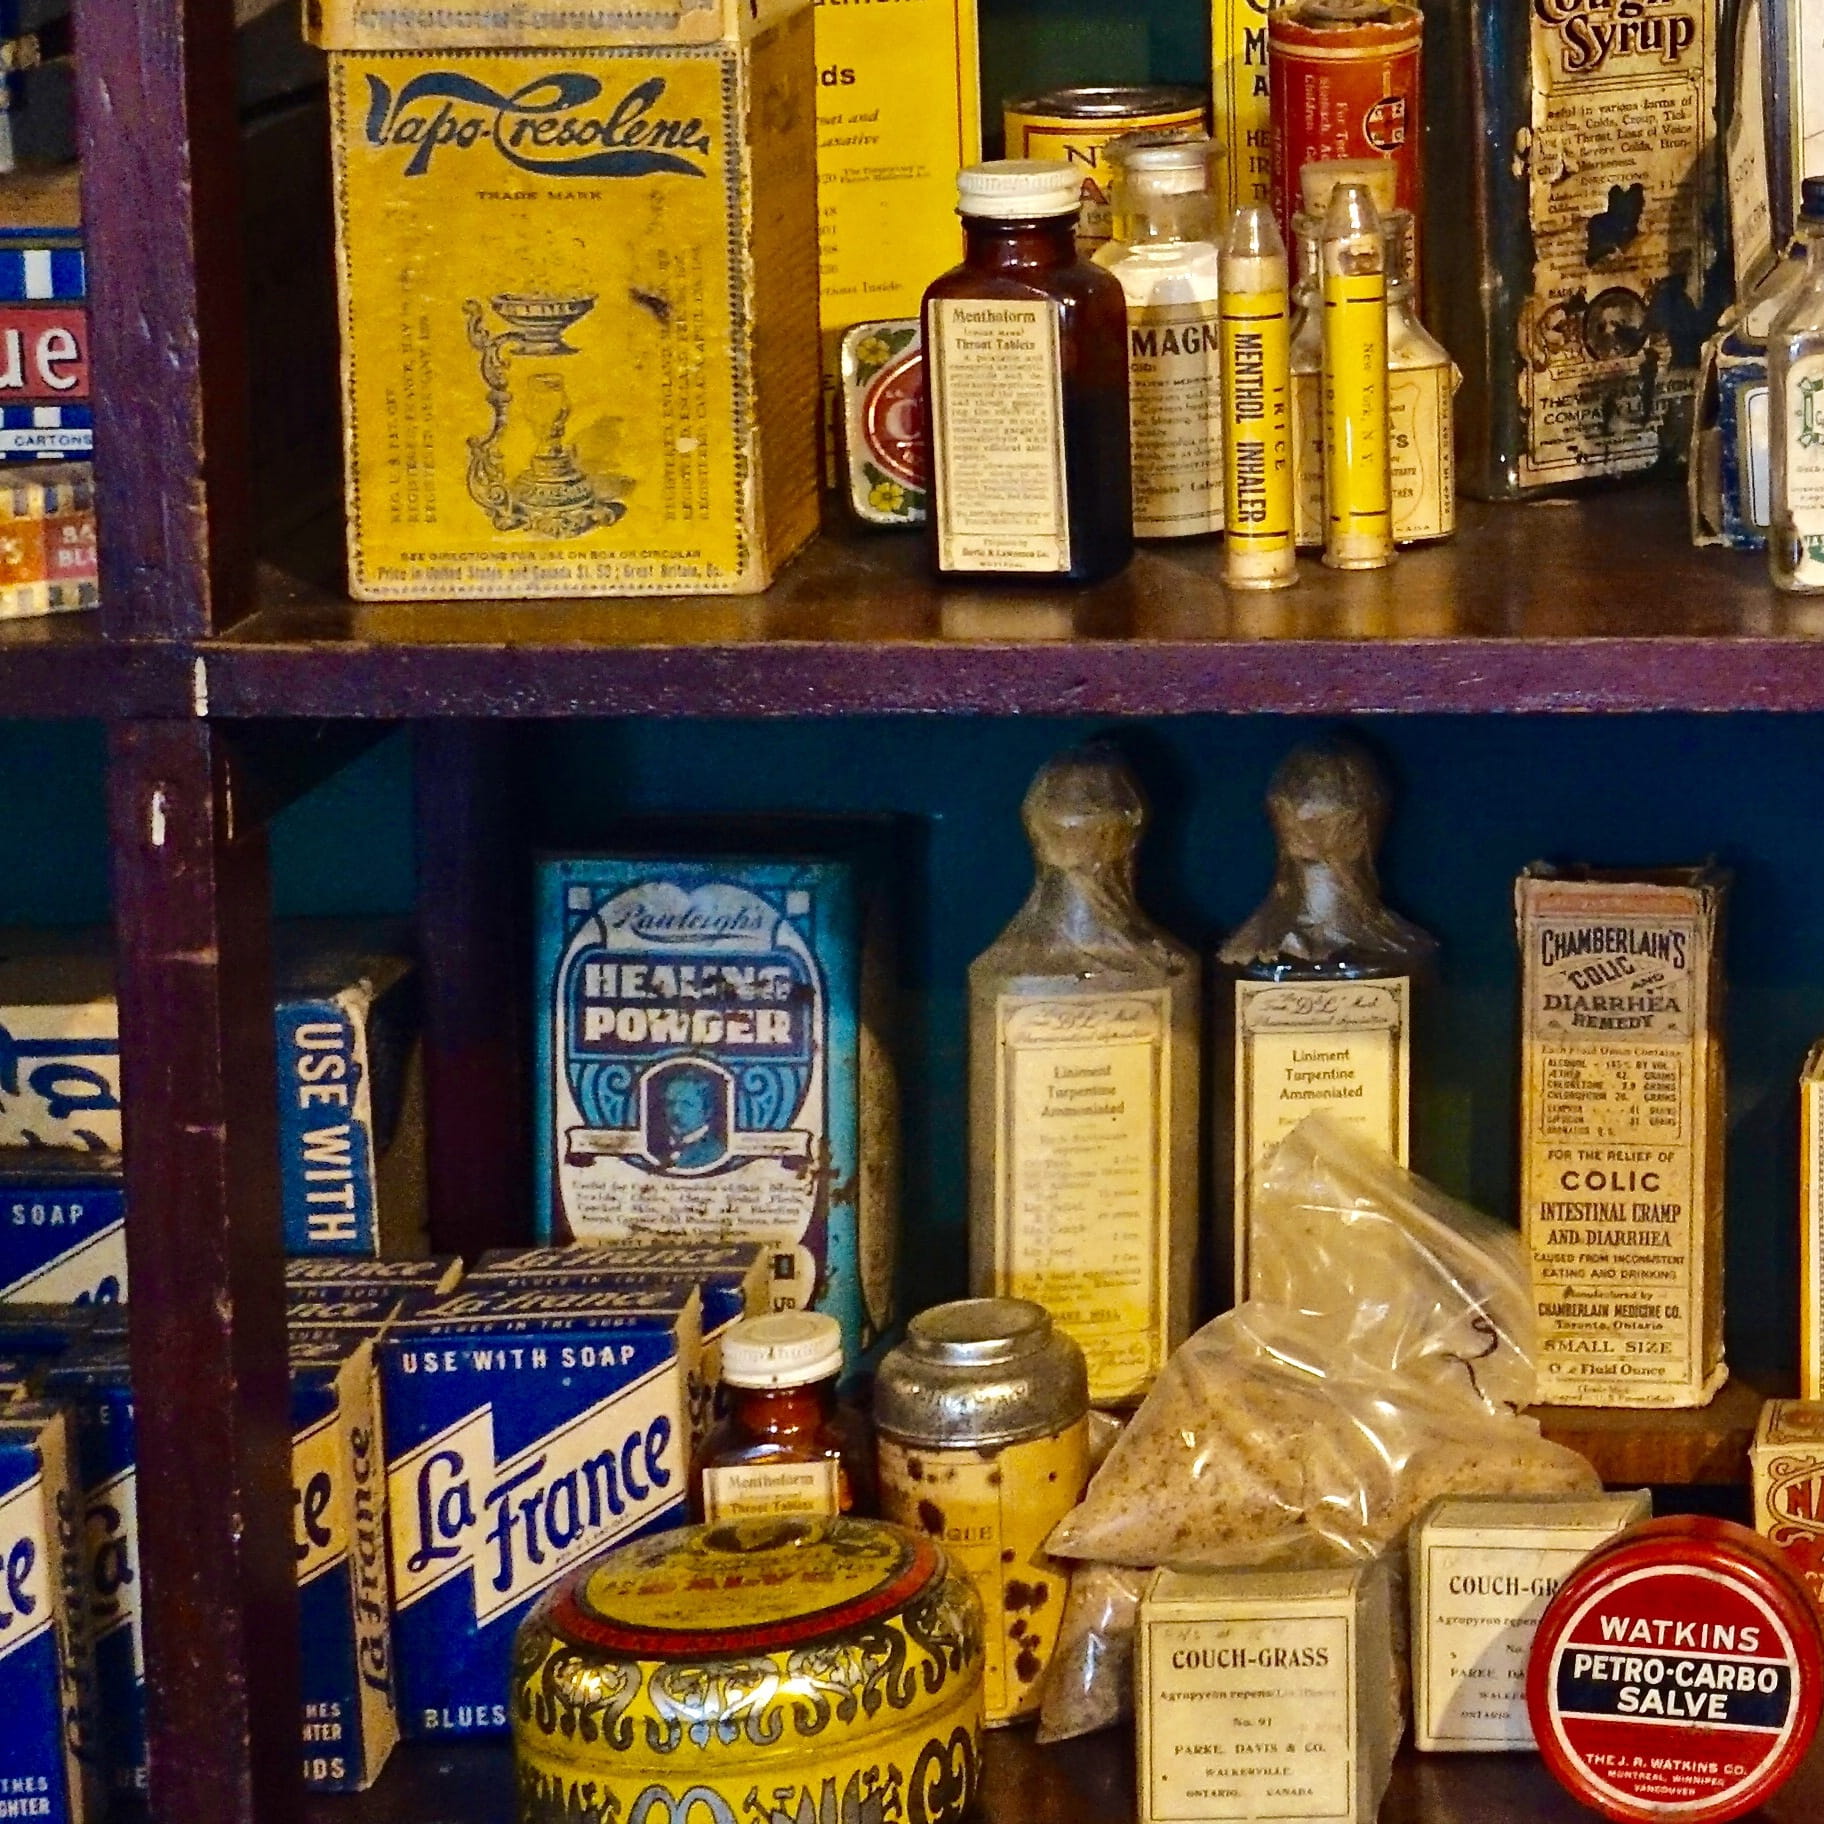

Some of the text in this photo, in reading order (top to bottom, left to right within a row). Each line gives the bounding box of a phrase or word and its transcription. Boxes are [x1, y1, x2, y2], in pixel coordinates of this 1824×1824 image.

[1561, 12, 1697, 73] Syrup
[1234, 330, 1268, 524] MENTHOL INHALER
[1541, 927, 1688, 971] CHAMBERLAIN'S
[583, 1007, 792, 1049] POWDER
[1278, 1083, 1365, 1102] Ammoniated
[1283, 1067, 1358, 1085] Turpentine
[299, 1022, 345, 1243] USE WITH
[1559, 1171, 1663, 1195] COLIC
[402, 1345, 636, 1375] USE WITH SOAP
[406, 1411, 677, 1583] La France
[1599, 1614, 1761, 1654] WATKINS
[1172, 1647, 1330, 1672] COUCH-GRASS
[1616, 1688, 1730, 1721] SALVE
